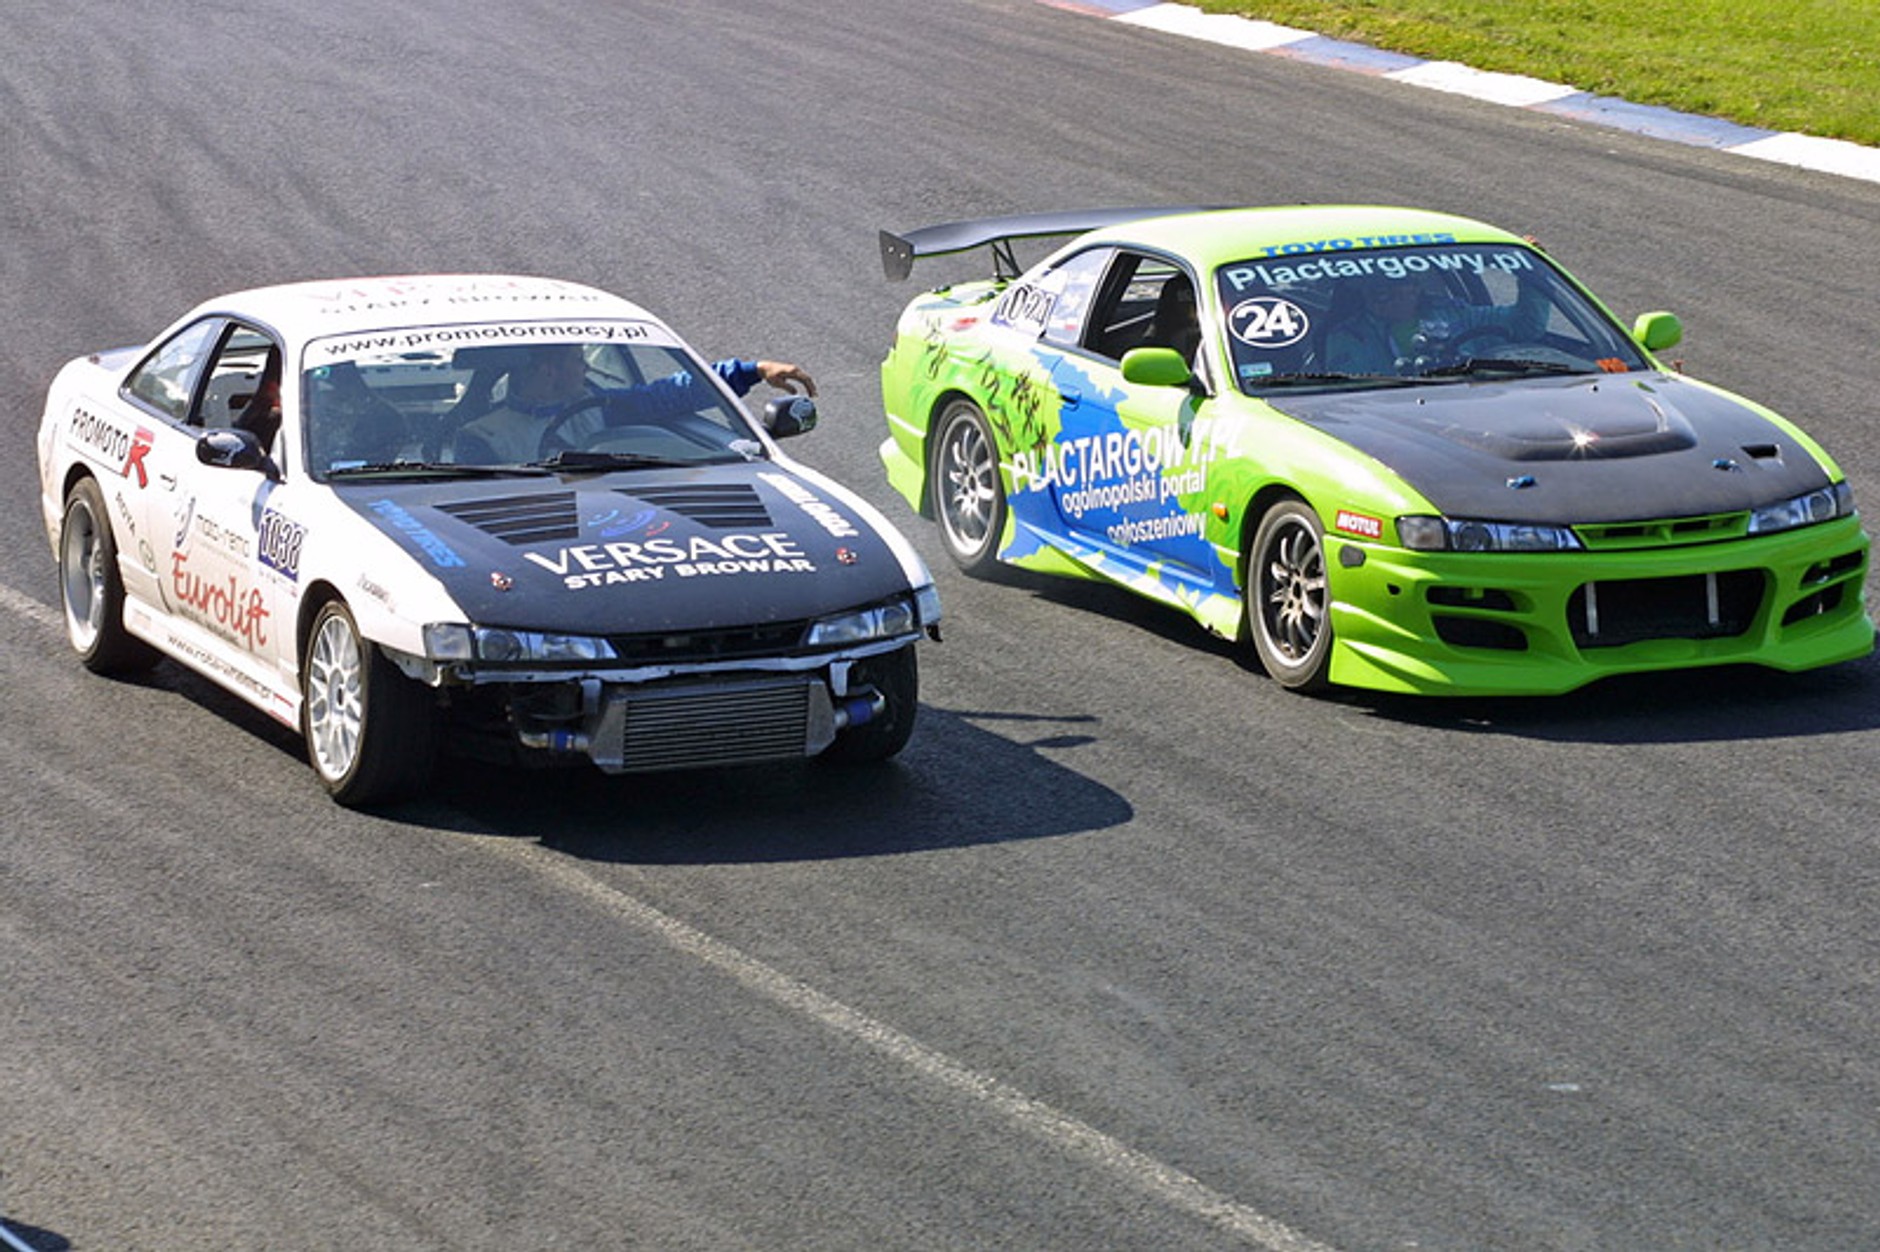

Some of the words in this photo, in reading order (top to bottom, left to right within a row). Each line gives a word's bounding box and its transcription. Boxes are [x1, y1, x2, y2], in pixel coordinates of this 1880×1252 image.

[1260, 238, 1354, 258] TOYO
[1356, 232, 1456, 247] TIRES
[1227, 250, 1534, 291] Plactargowy.pl
[325, 324, 649, 356] www.promotormocy.pl
[1236, 303, 1299, 340] 24
[1062, 470, 1157, 519] ogólnopolski
[1160, 464, 1207, 505] portal
[1337, 512, 1379, 537] MOTUL
[523, 533, 806, 576] VERSACE
[564, 565, 664, 589] STARY
[674, 557, 817, 577] BROWAR
[172, 551, 269, 652] Eurolift
